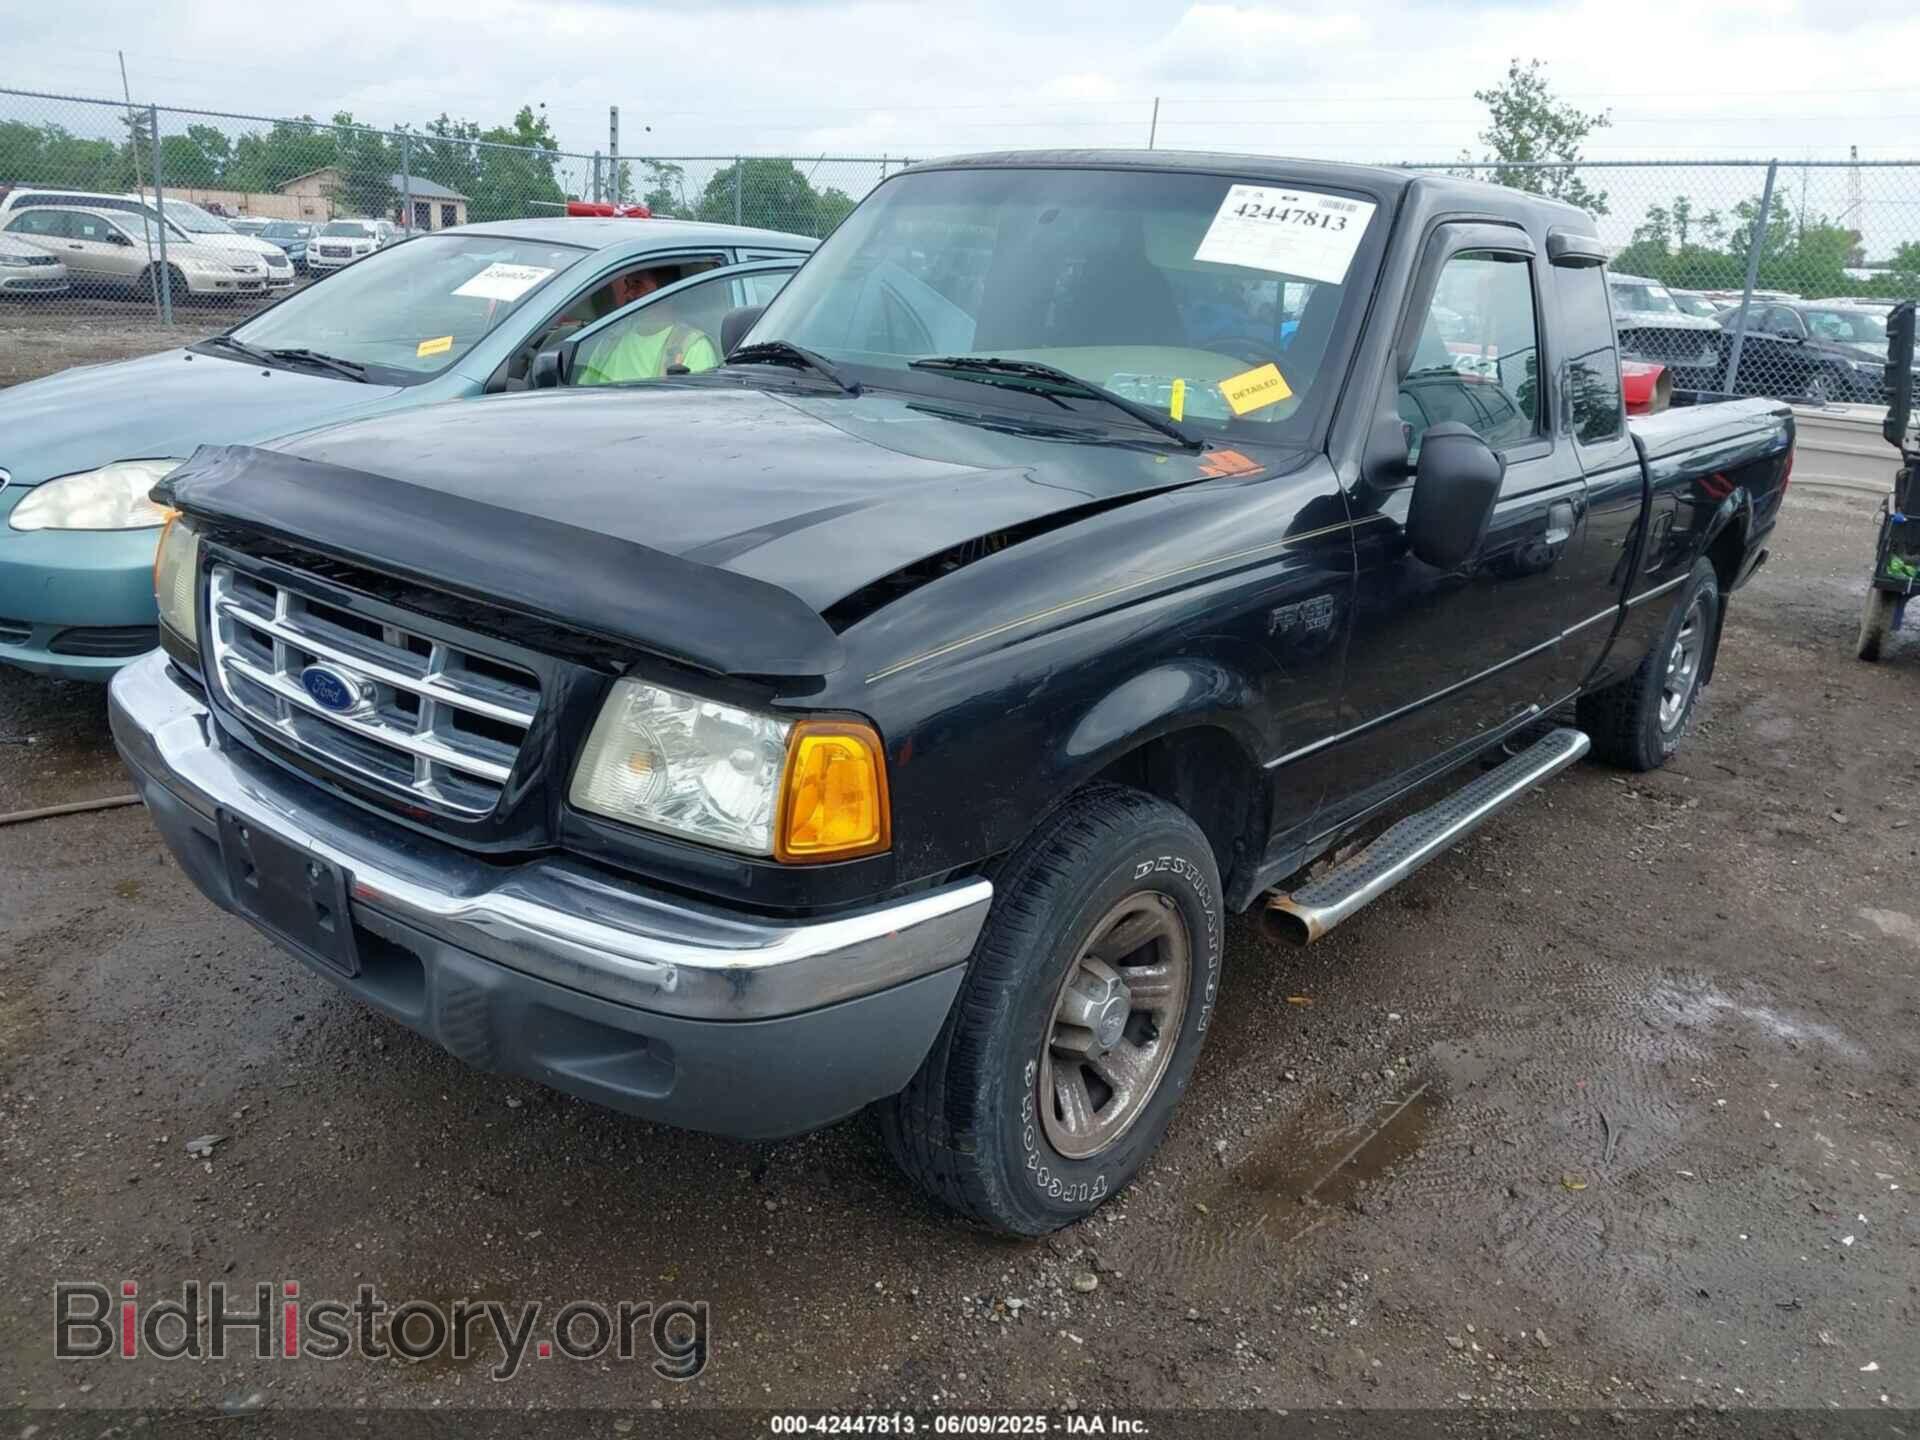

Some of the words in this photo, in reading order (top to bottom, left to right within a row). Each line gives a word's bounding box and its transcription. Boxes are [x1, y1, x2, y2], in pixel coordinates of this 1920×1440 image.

[1233, 203, 1348, 232] 42447813
[1232, 378, 1278, 401] DETAILED
[311, 674, 341, 703] Ford
[1134, 856, 1218, 1032] DESTINATION
